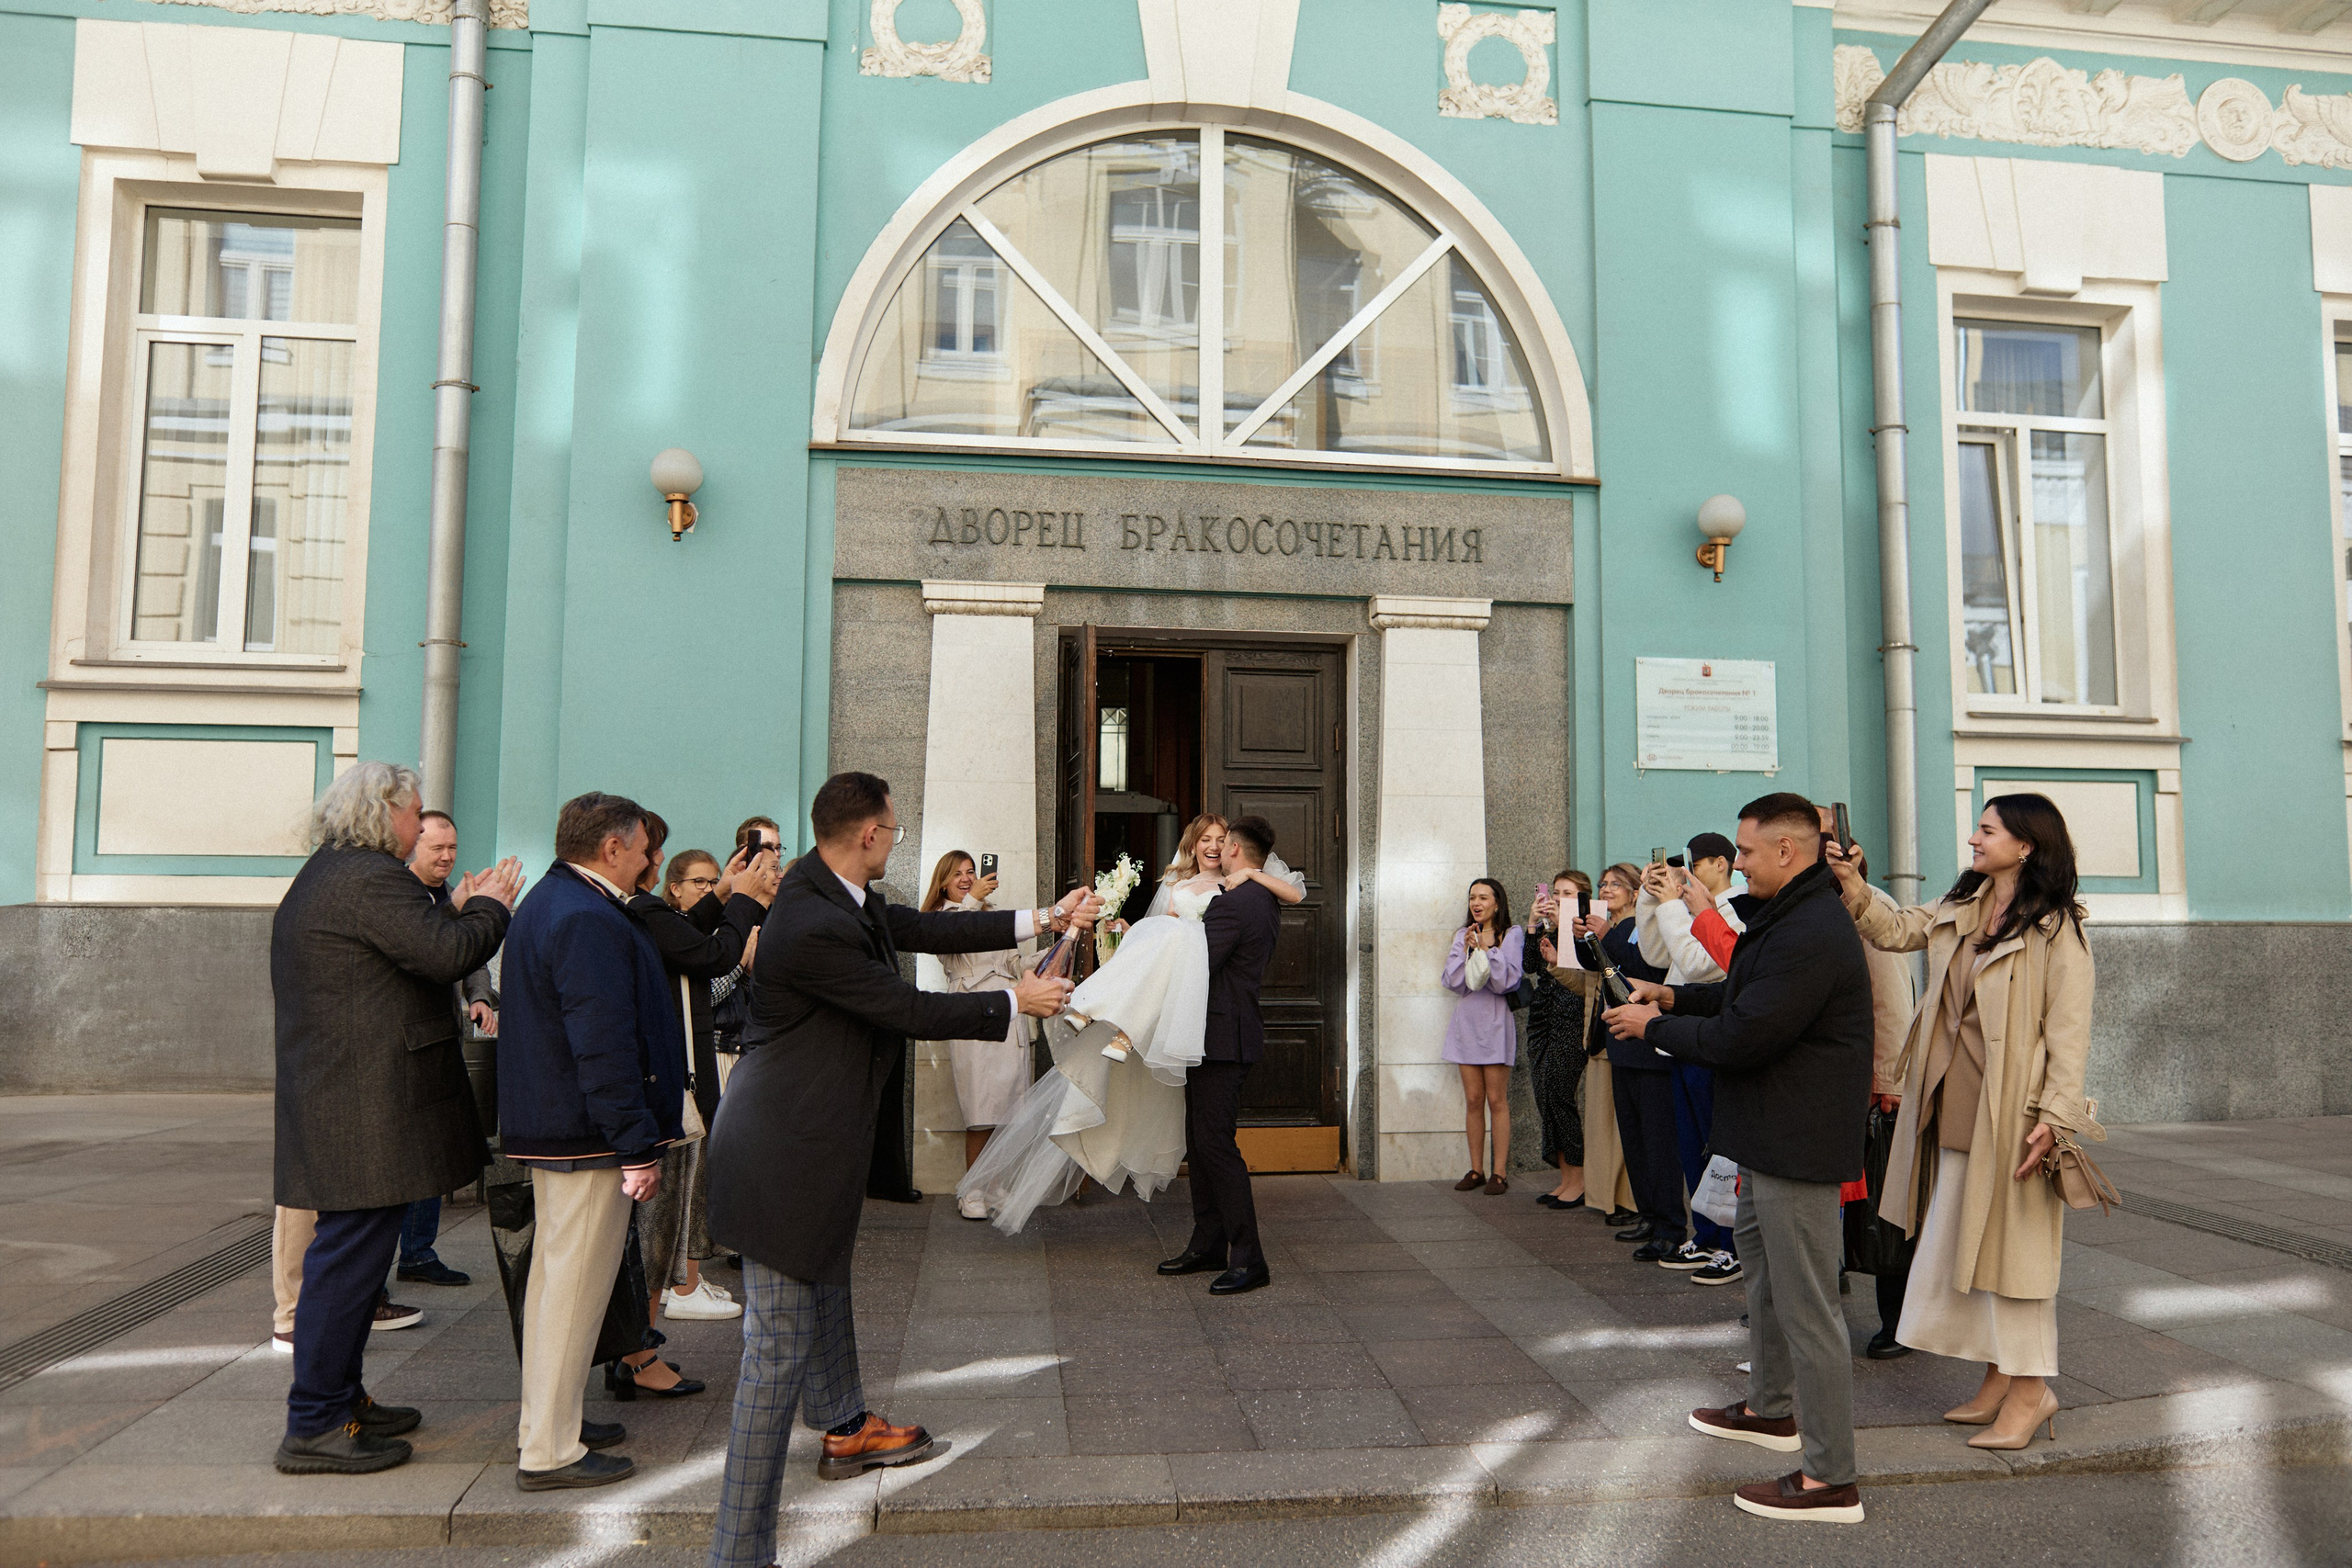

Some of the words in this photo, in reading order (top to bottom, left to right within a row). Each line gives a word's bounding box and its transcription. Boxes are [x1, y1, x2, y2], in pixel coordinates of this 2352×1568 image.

[928, 506, 1086, 552] ДВОРЕЦ
[1119, 510, 1487, 563] БРАКОСОЧЕТАНИЯ
[1657, 687, 1684, 695] Дворец
[1685, 688, 1741, 696] бракосочетания
